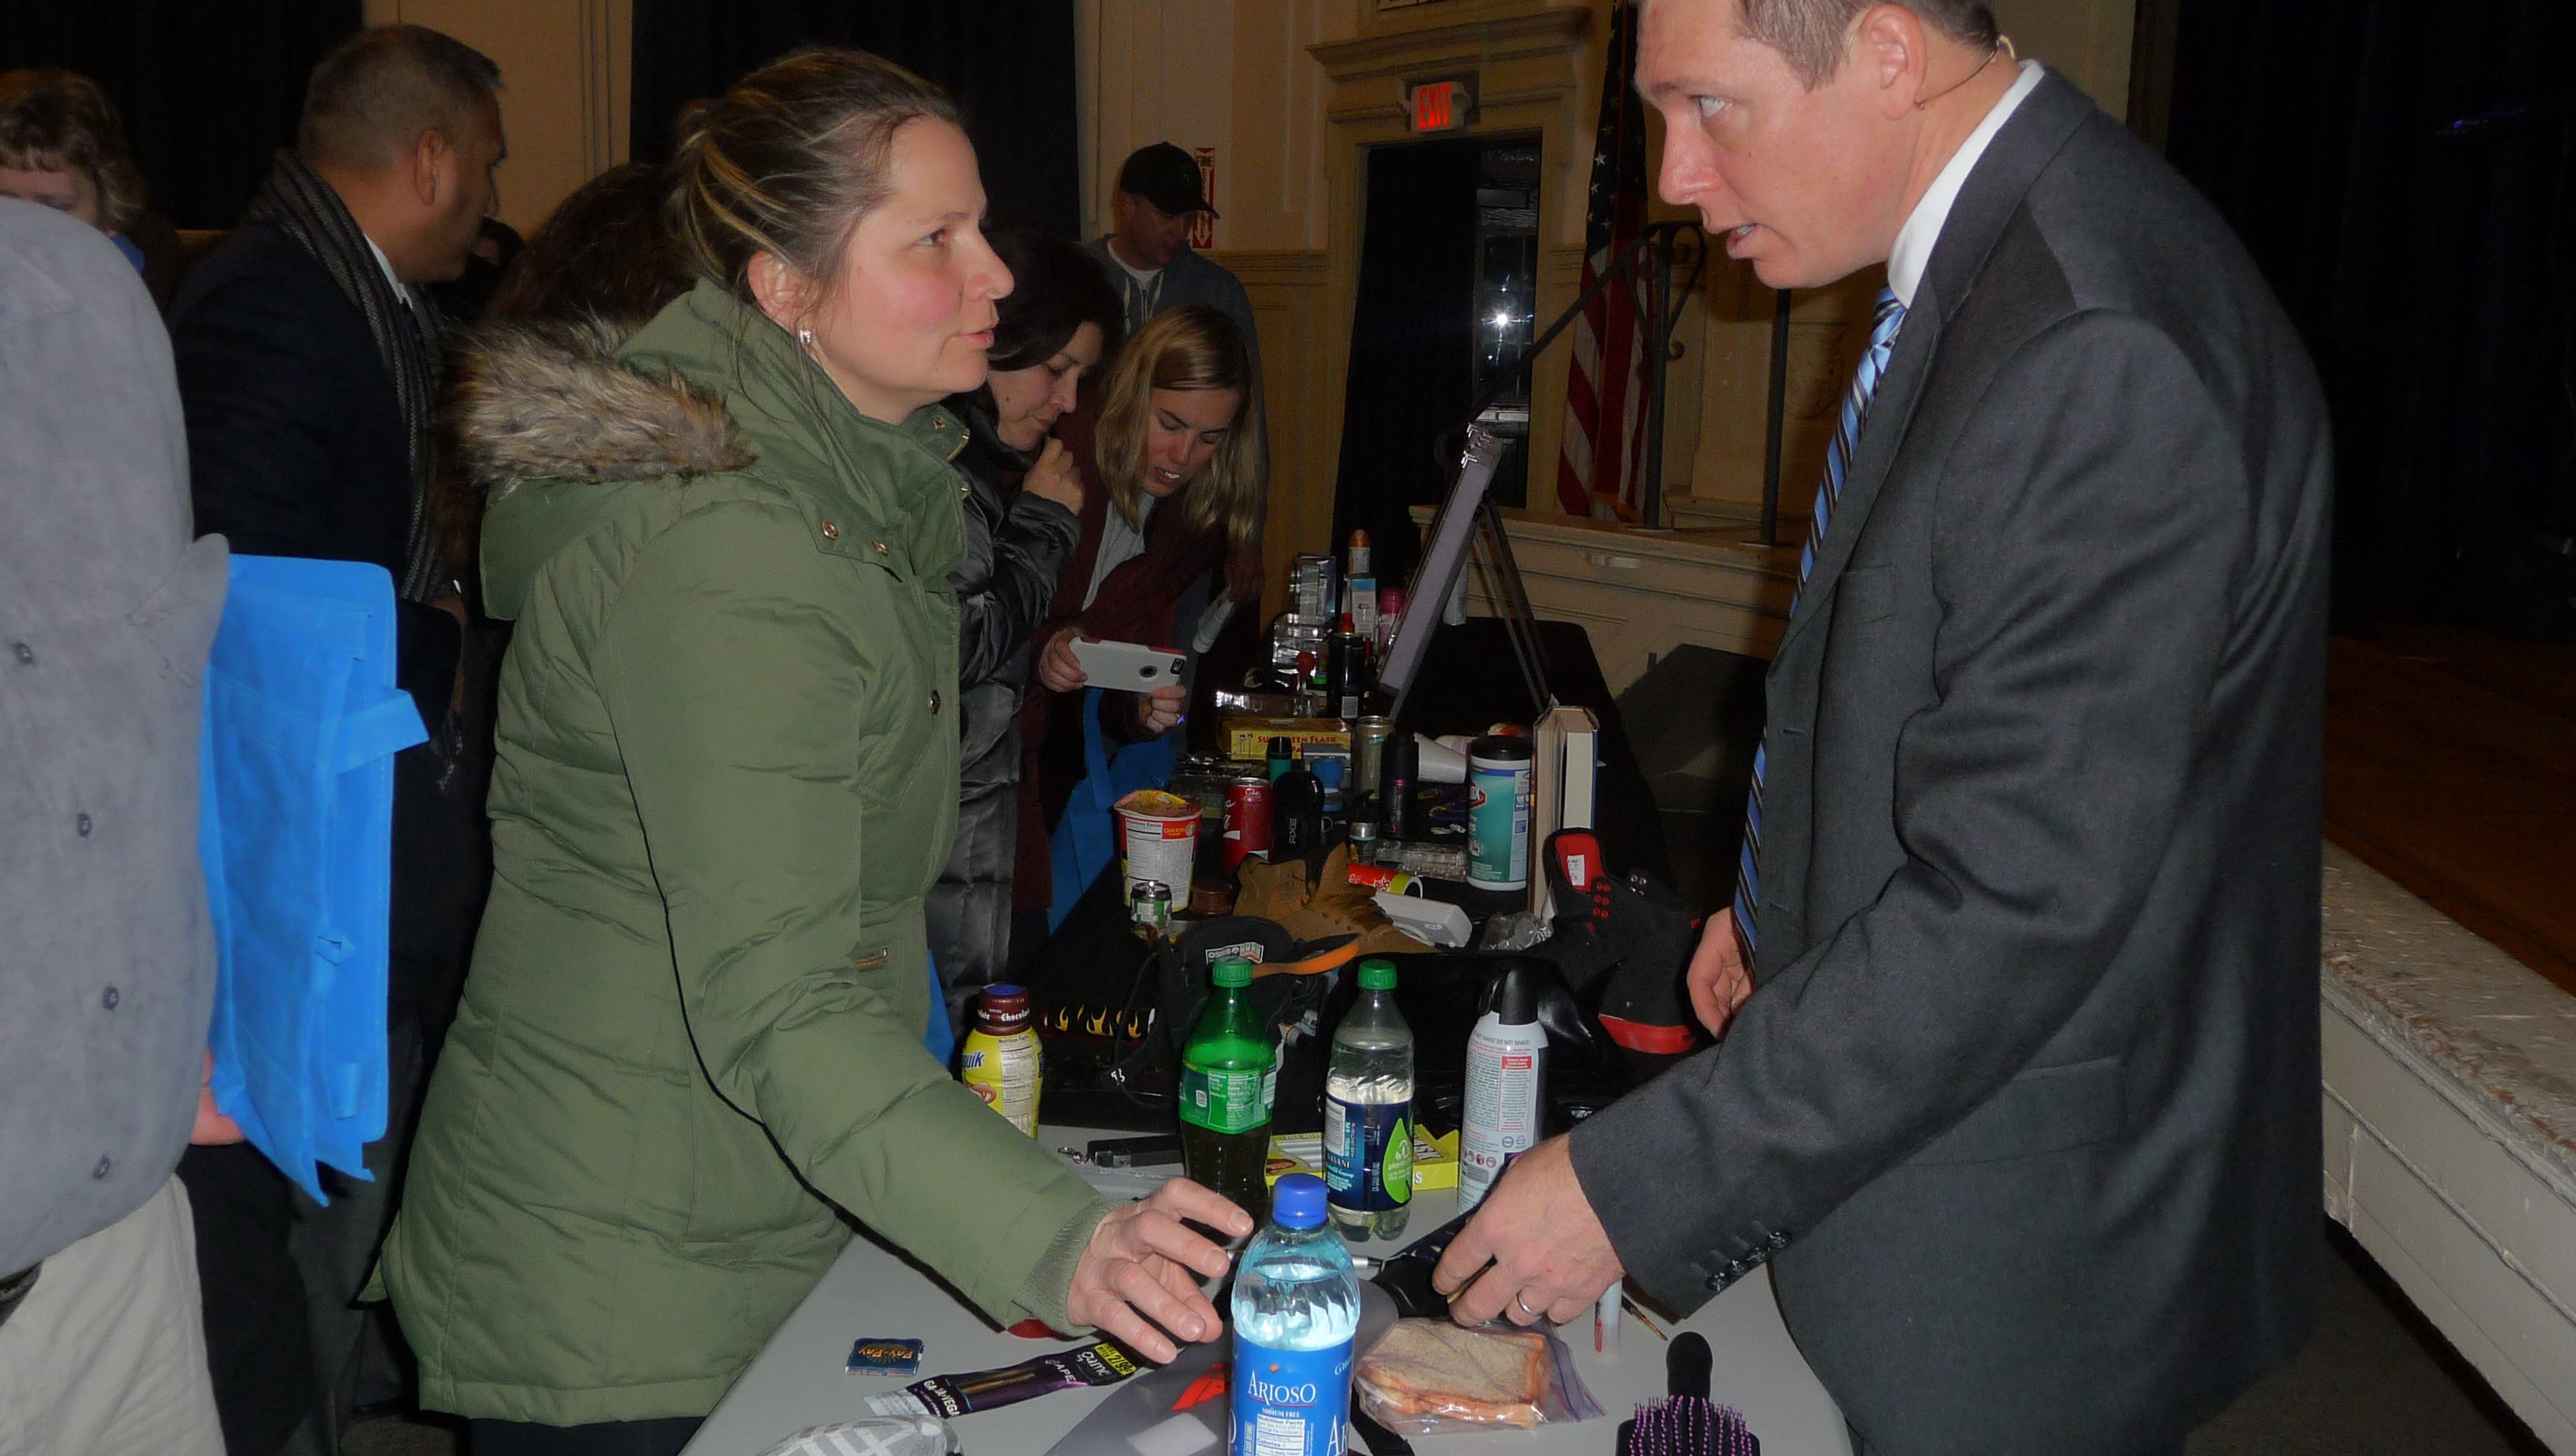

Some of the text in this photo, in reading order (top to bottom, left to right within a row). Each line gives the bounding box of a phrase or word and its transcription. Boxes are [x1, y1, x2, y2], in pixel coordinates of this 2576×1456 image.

[1419, 84, 1450, 129] EXIT
[1310, 735, 1336, 743] FLASK
[1289, 817, 1297, 845] AXE
[1001, 1008, 1031, 1022] Chocolat
[1248, 1370, 1316, 1405] ARIOSO
